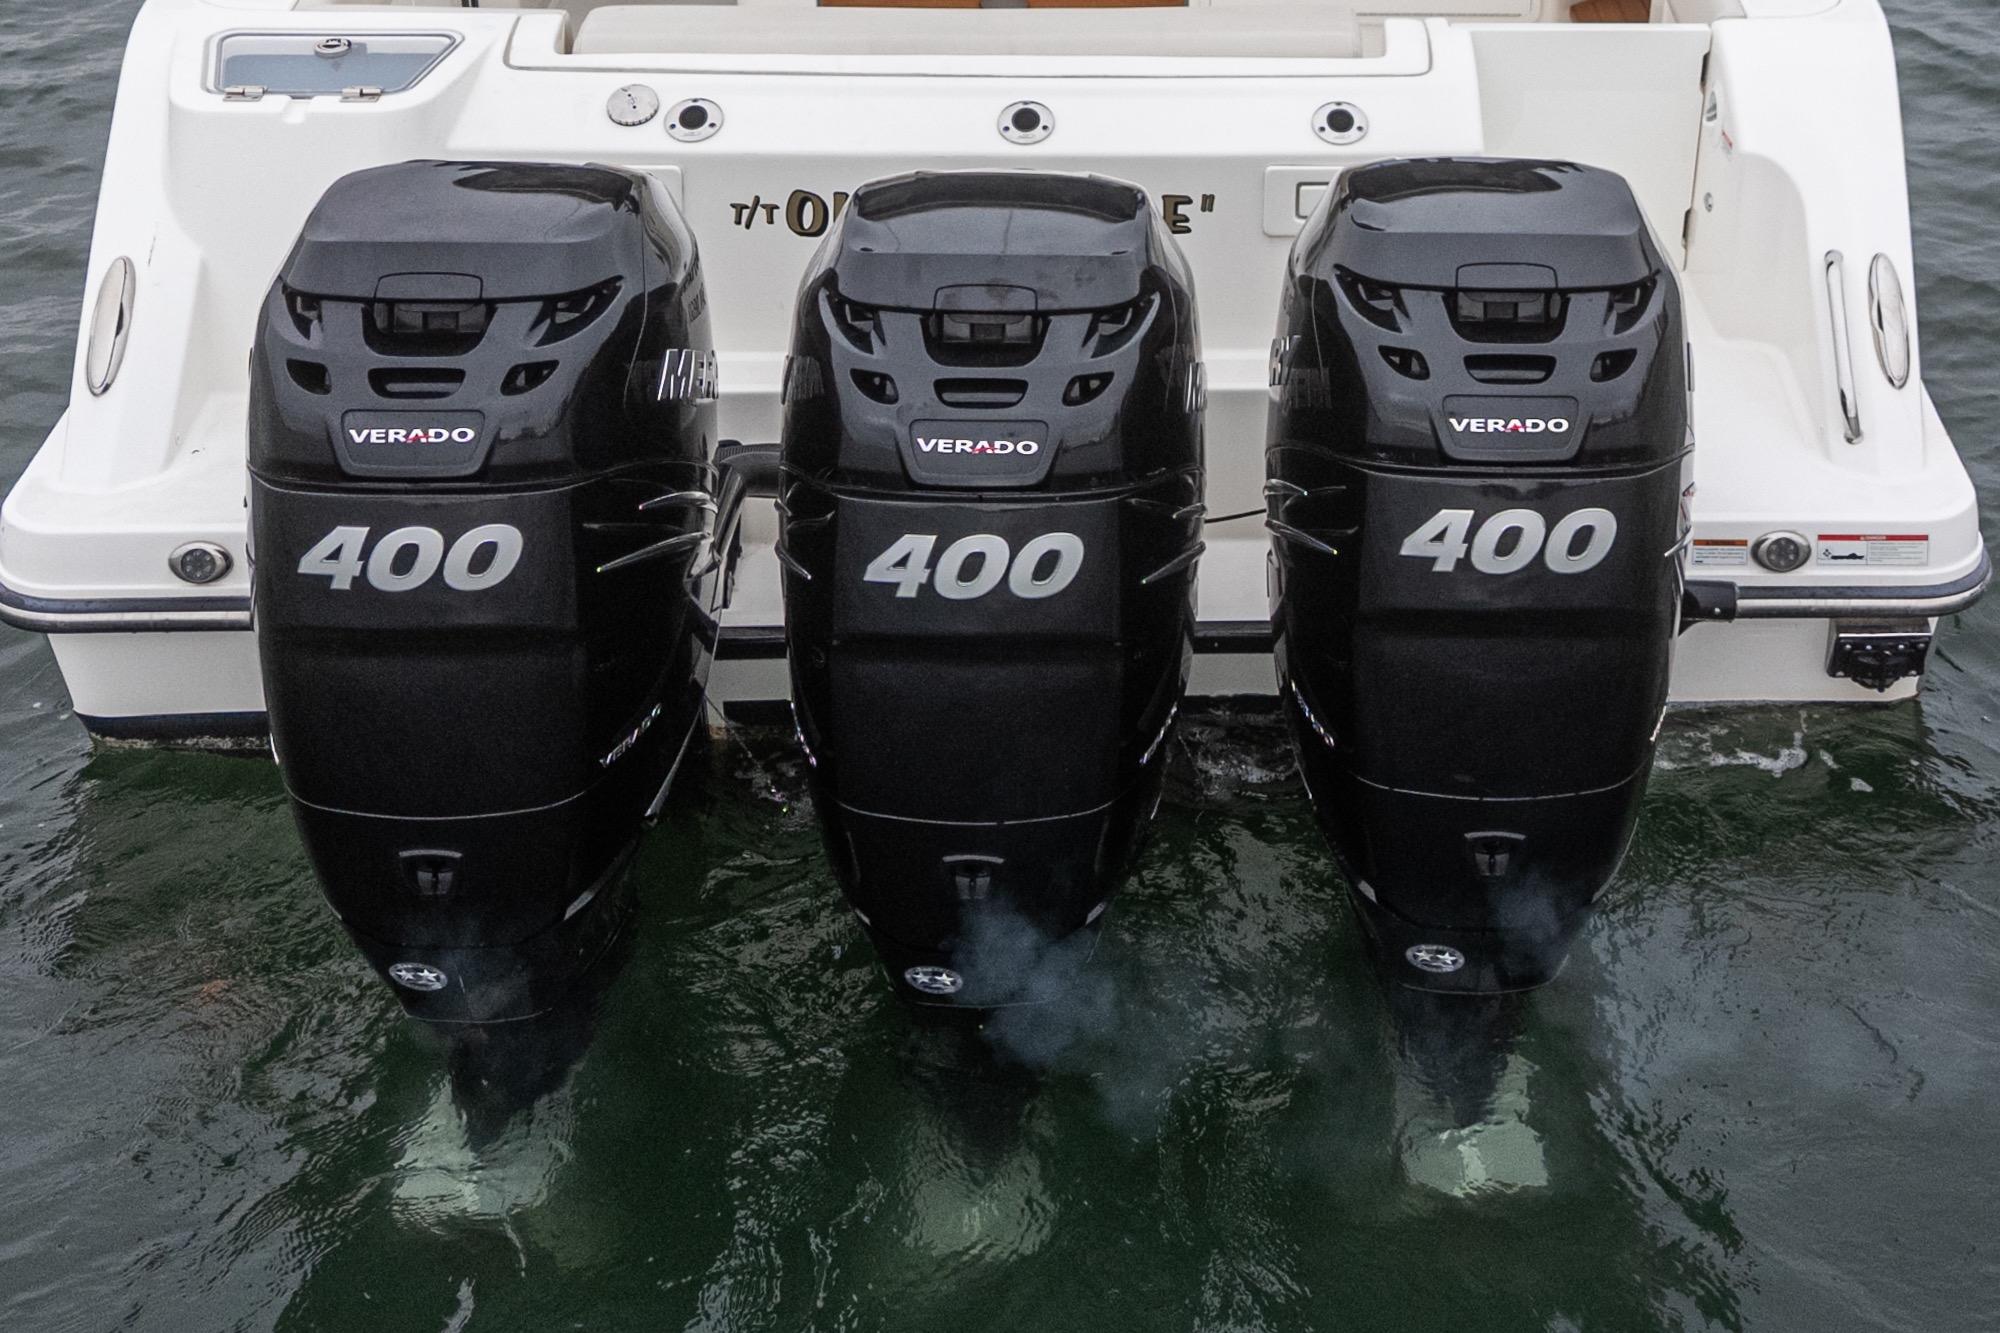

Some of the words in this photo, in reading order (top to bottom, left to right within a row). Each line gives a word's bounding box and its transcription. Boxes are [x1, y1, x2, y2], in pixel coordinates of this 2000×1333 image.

[730, 195, 780, 230] T/T
[348, 428, 476, 444] VERADO
[1449, 418, 1569, 433] VERADO
[916, 438, 1039, 455] VERADO
[298, 524, 523, 591] 400
[1400, 508, 1617, 574] 400
[863, 532, 1084, 599] 400
